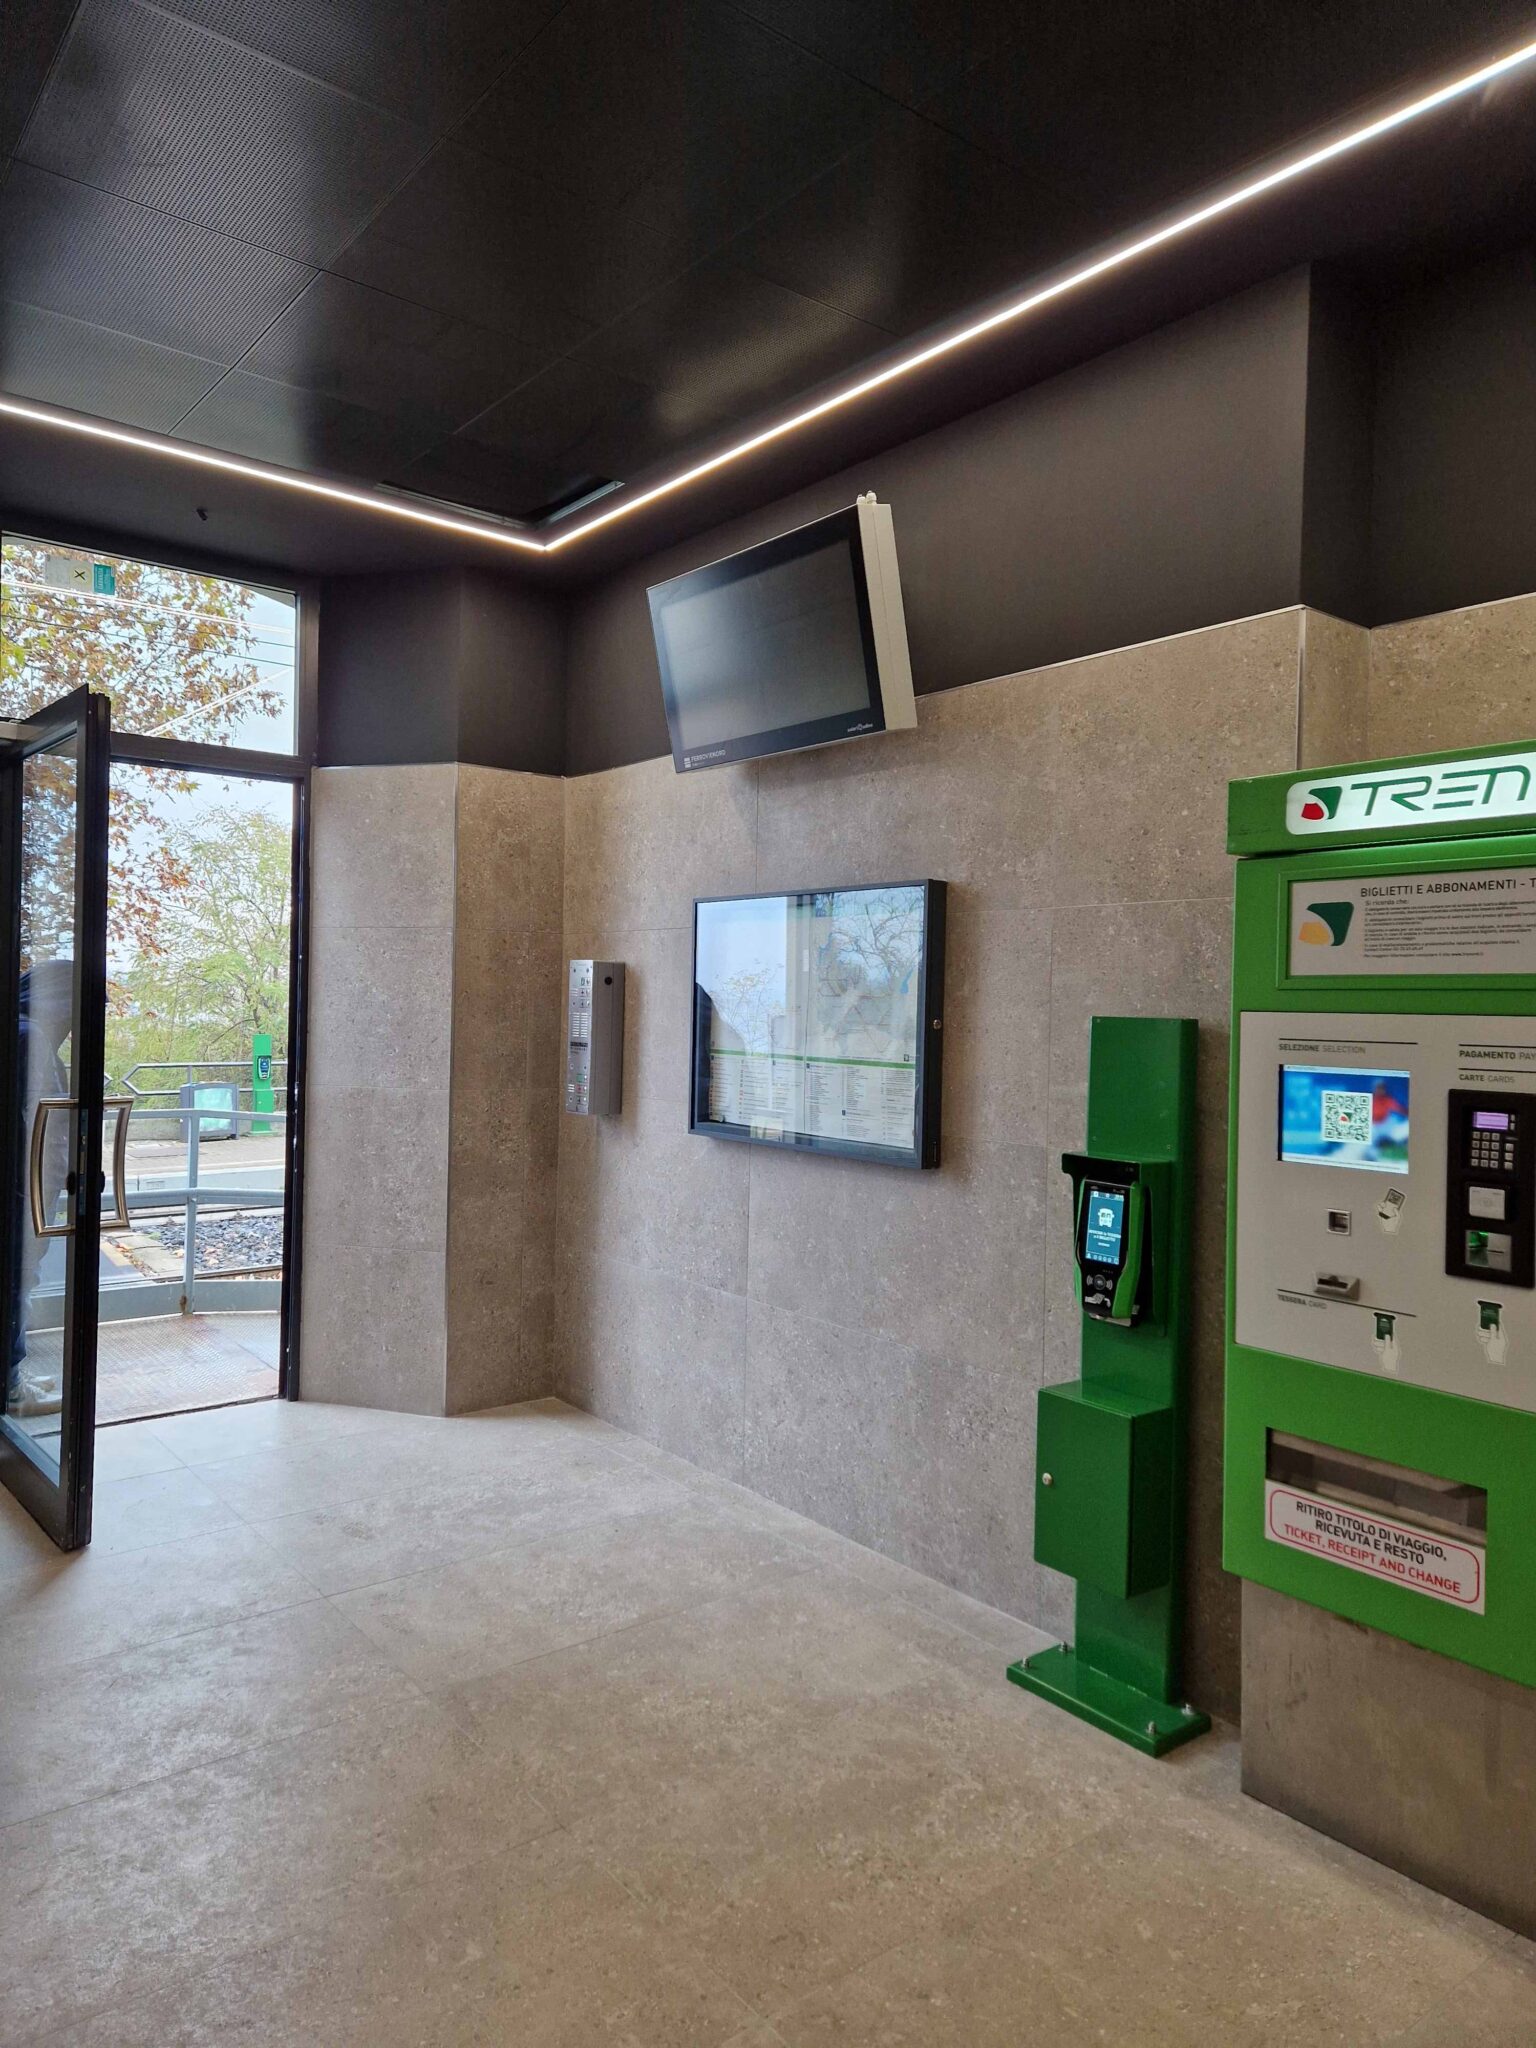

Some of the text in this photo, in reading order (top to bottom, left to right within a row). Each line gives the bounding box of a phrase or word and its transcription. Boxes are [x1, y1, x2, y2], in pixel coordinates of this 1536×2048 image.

[1350, 764, 1536, 816] TREN
[1360, 885, 1413, 898] BIGLIETTI
[1417, 884, 1424, 895] E
[1426, 879, 1517, 894] ABBONAMENTI
[1279, 1043, 1366, 1054] SELEZIONE SELECTION
[1459, 1050, 1516, 1060] PAGAMENTO
[1487, 1075, 1516, 1084] CARDS
[1296, 1501, 1333, 1522] RITIRO
[1335, 1513, 1376, 1536] TITOLO
[1379, 1528, 1391, 1541] DI
[1315, 1520, 1424, 1565] RICEVUTA E RESTO
[1328, 1538, 1376, 1564] RECEIPT
[1379, 1557, 1406, 1575] AND
[1408, 1566, 1461, 1594] CHANGE
